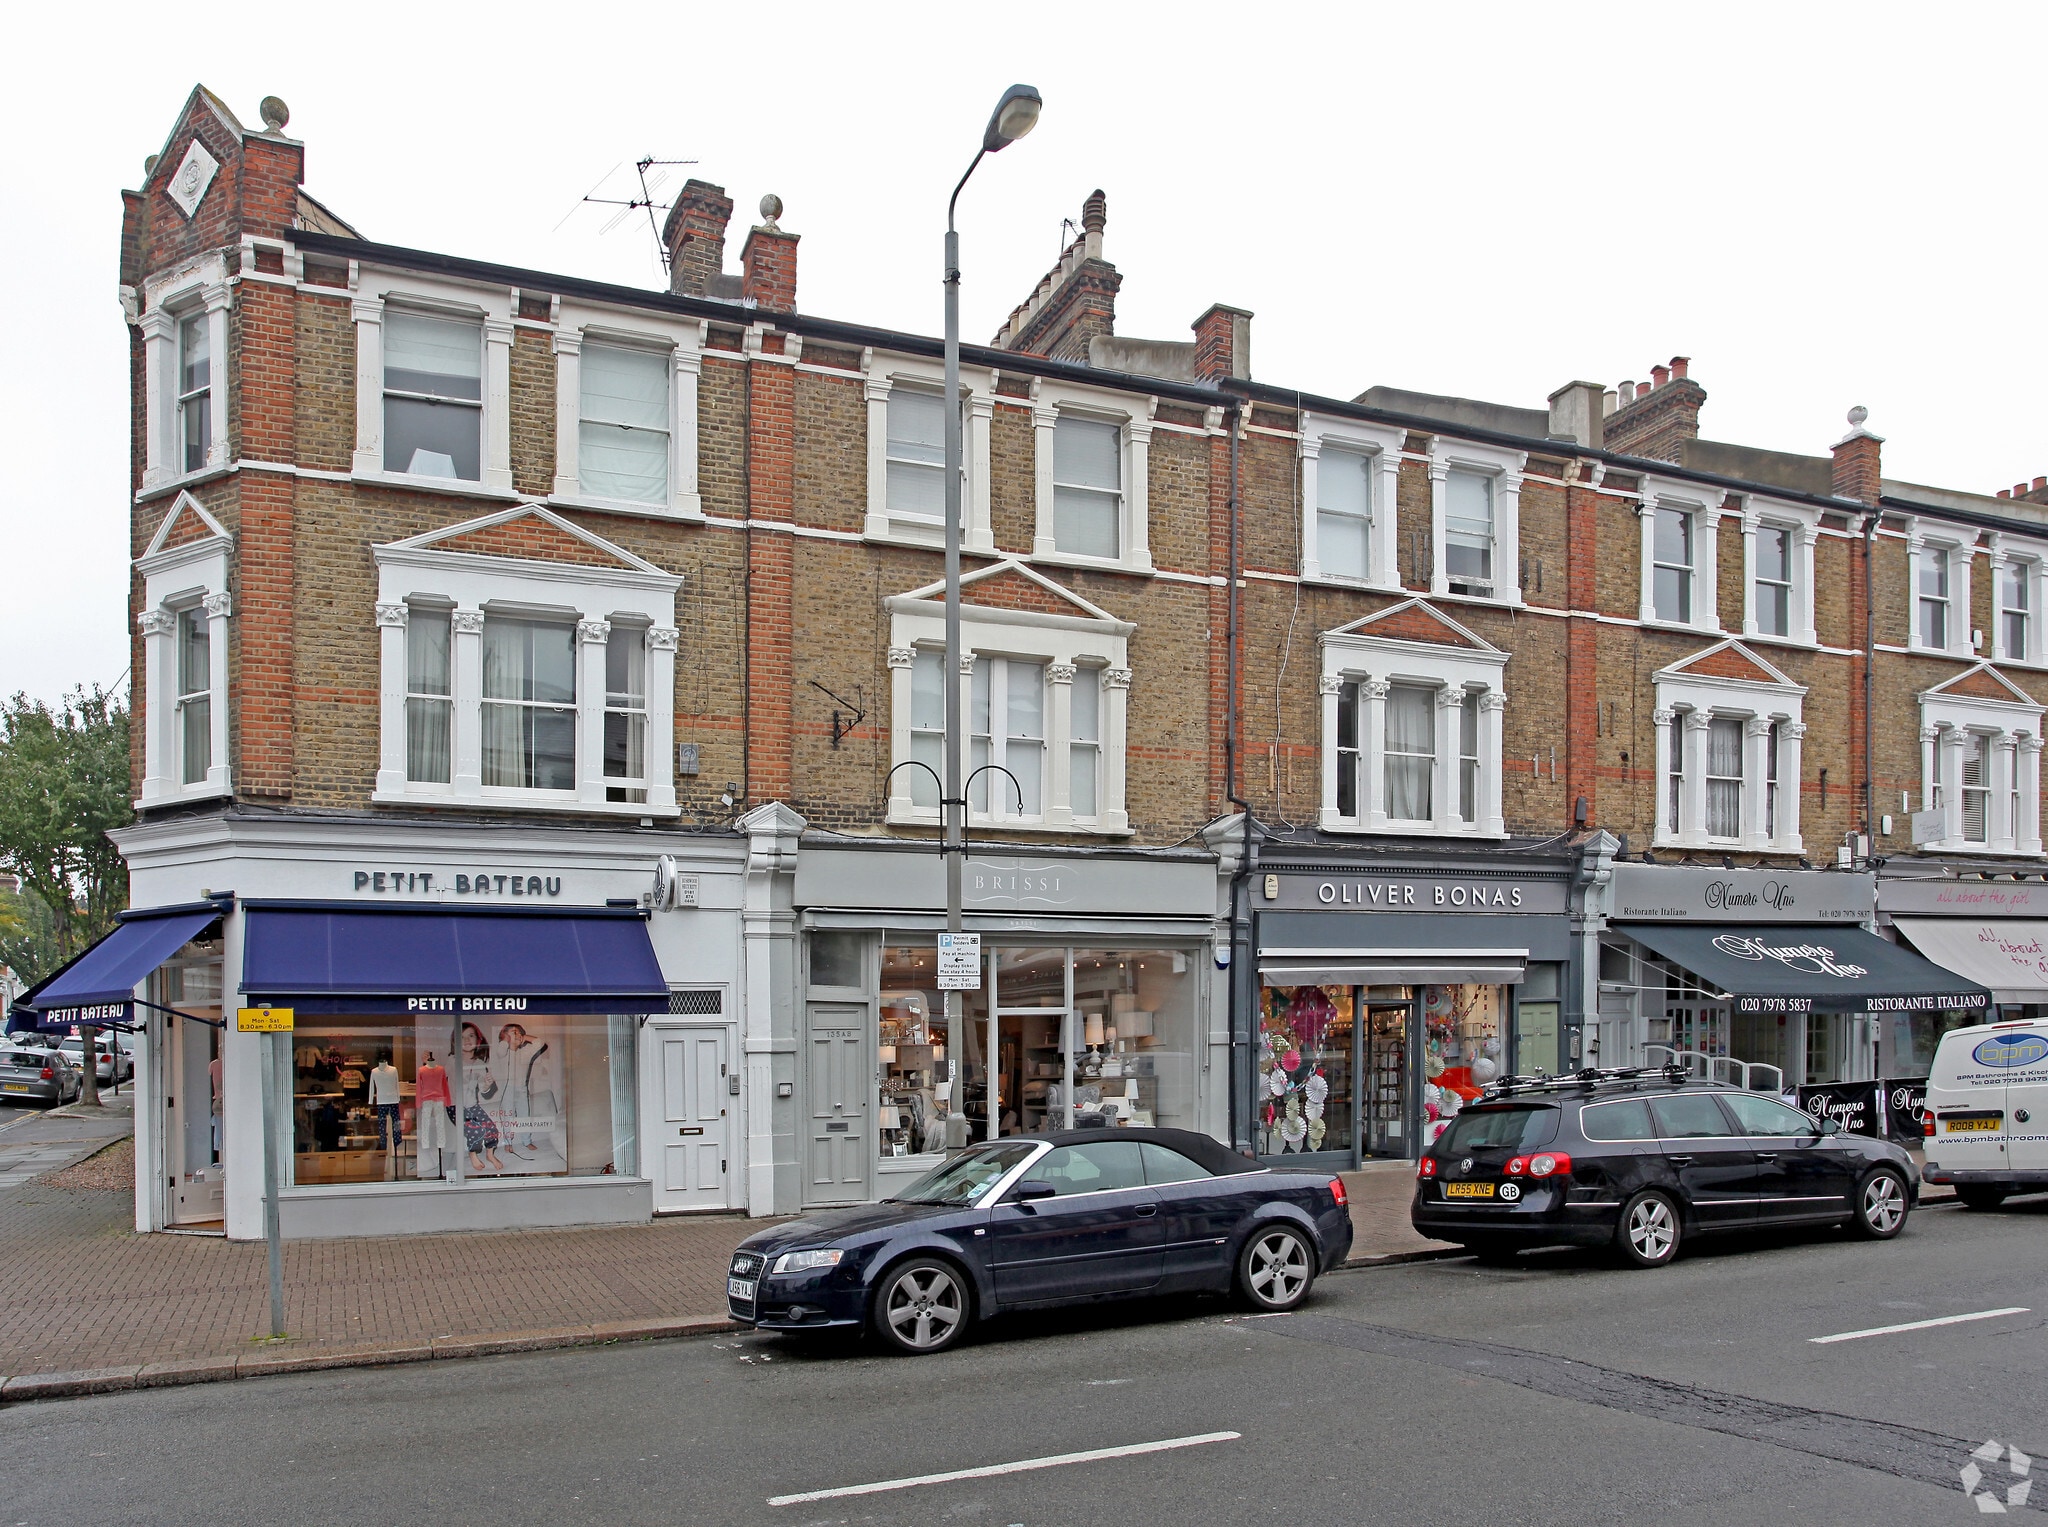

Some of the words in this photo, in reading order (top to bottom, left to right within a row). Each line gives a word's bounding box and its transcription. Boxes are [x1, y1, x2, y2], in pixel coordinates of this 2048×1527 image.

[354, 871, 433, 892] PETIT
[455, 874, 561, 896] BATEAU
[975, 875, 1060, 891] BRISSI
[1318, 882, 1415, 903] OLIVER
[1434, 885, 1522, 907] BONAS
[1704, 880, 1758, 911] Numero
[1762, 880, 1795, 911] Uno
[1937, 887, 1953, 903] all
[1955, 887, 1987, 904] about
[1988, 888, 2006, 904] the
[2006, 889, 2030, 913] girl
[1623, 906, 1659, 916] Ristorante
[1660, 907, 1687, 917] Italiano
[1830, 910, 1841, 918] 020
[1842, 910, 1856, 918] 7978
[1857, 910, 1871, 918] 5837
[942, 936, 950, 946] P
[1978, 928, 2000, 943] all
[1712, 934, 1835, 961] Numero
[2000, 938, 2043, 953] about
[1781, 956, 1868, 979] Uno
[2010, 955, 2032, 966] the
[407, 997, 456, 1011] PETIT
[461, 997, 527, 1011] BATEAU
[1740, 998, 1760, 1012] 020
[1762, 998, 1787, 1012] 7978
[1788, 998, 1812, 1012] 5837
[1867, 996, 1934, 1011] RISTORANTE
[1937, 995, 1986, 1009] ITALIANO
[47, 1007, 79, 1023] PETIT
[81, 1003, 124, 1020] BATEAU
[1981, 1045, 2042, 1064] bpm
[1975, 1071, 2018, 1079] Bathrooms
[489, 1109, 513, 1117] GIRLS
[1808, 1094, 1865, 1117] Numero
[1831, 1111, 1865, 1133] Uno
[1976, 1120, 1997, 1130] YAJ
[1450, 1183, 1473, 1194] LR55
[1473, 1183, 1491, 1195] XNE
[1502, 1188, 1517, 1198] GB
